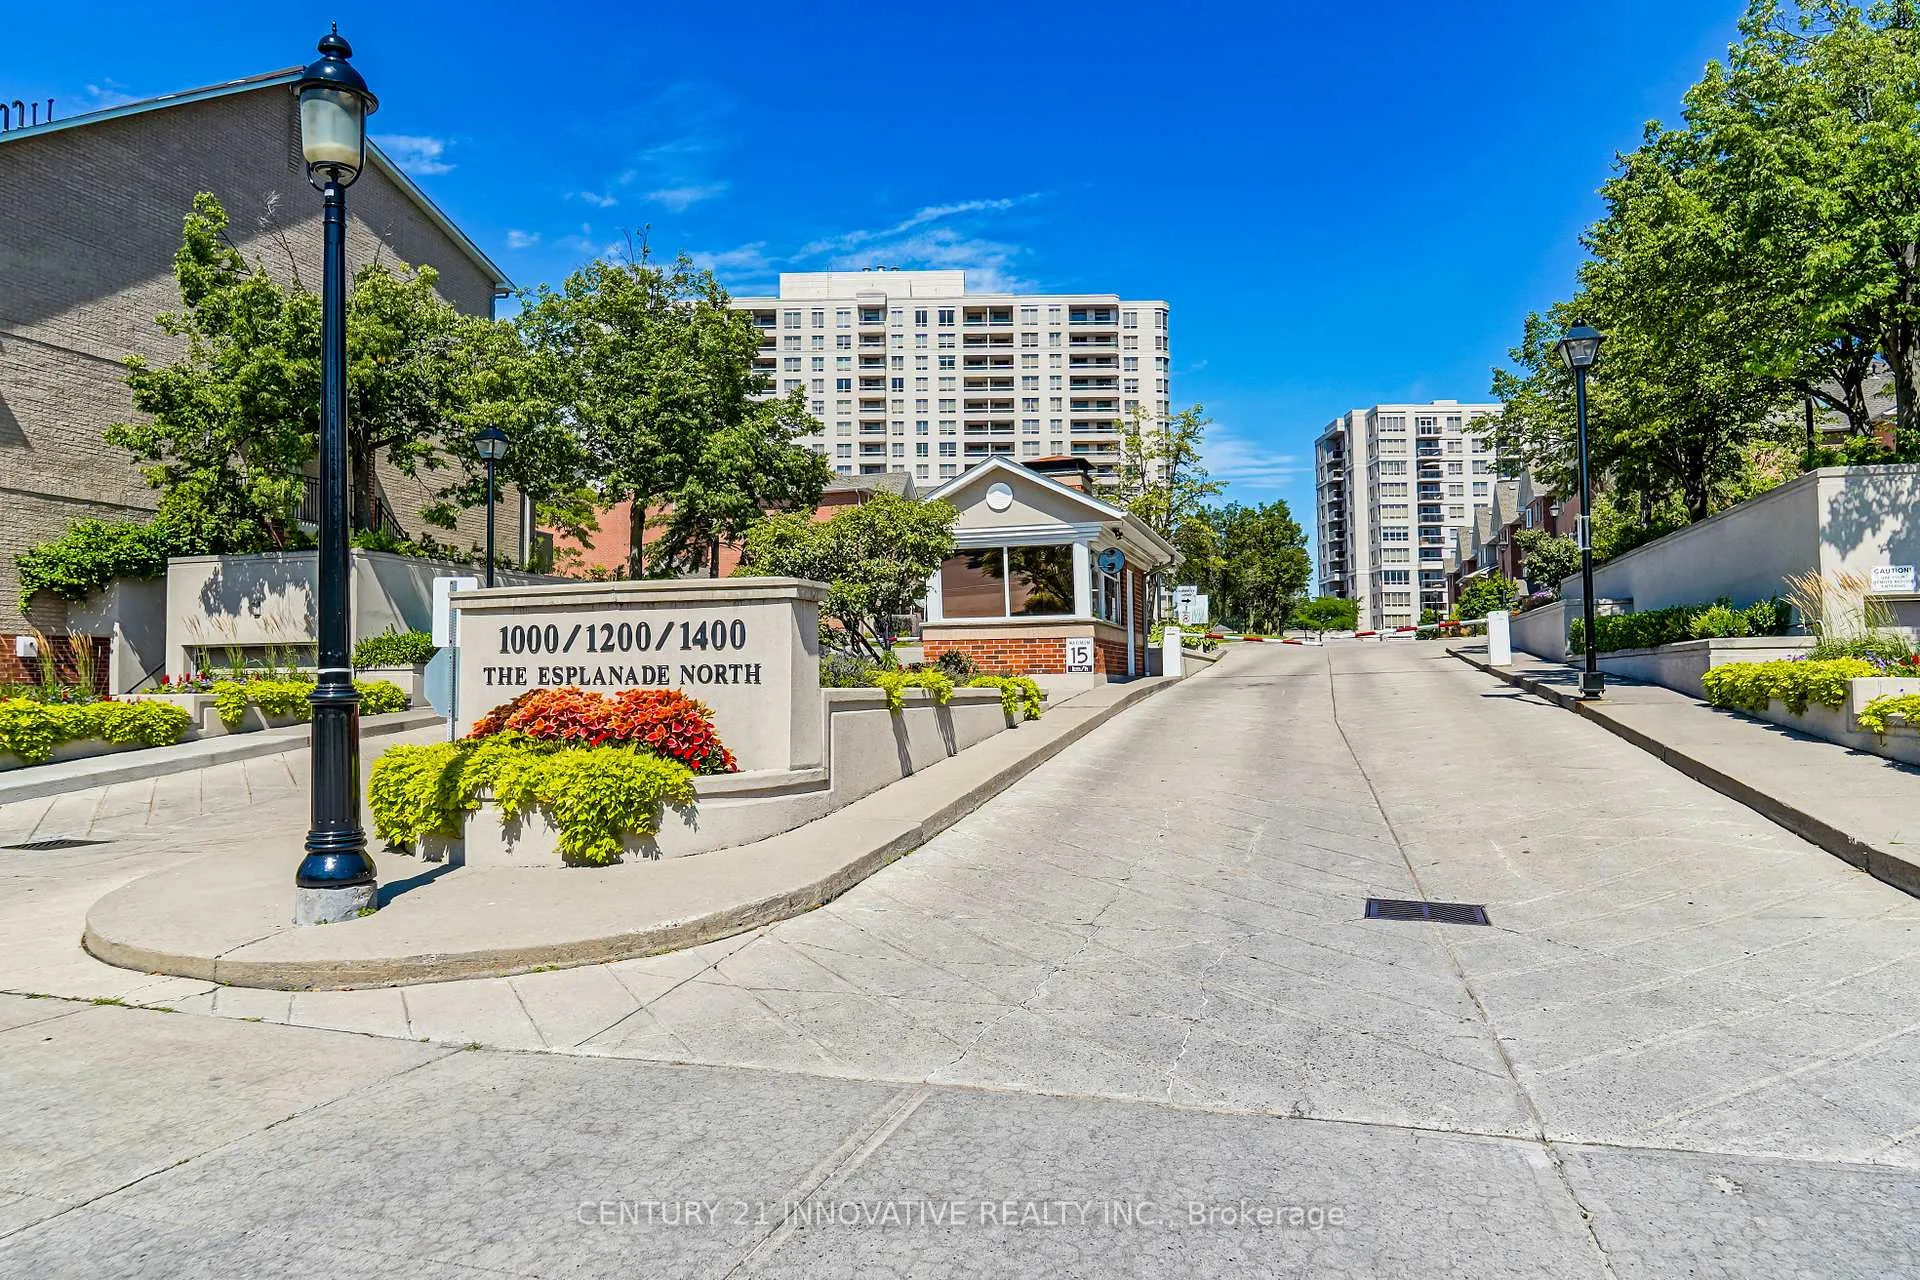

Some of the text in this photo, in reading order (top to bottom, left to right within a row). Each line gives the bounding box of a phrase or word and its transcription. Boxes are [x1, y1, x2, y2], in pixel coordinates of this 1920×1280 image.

[499, 619, 746, 654] 1000/1200/1400
[1071, 646, 1088, 664] 15
[483, 663, 762, 686] THE ESPLANADE NORTH
